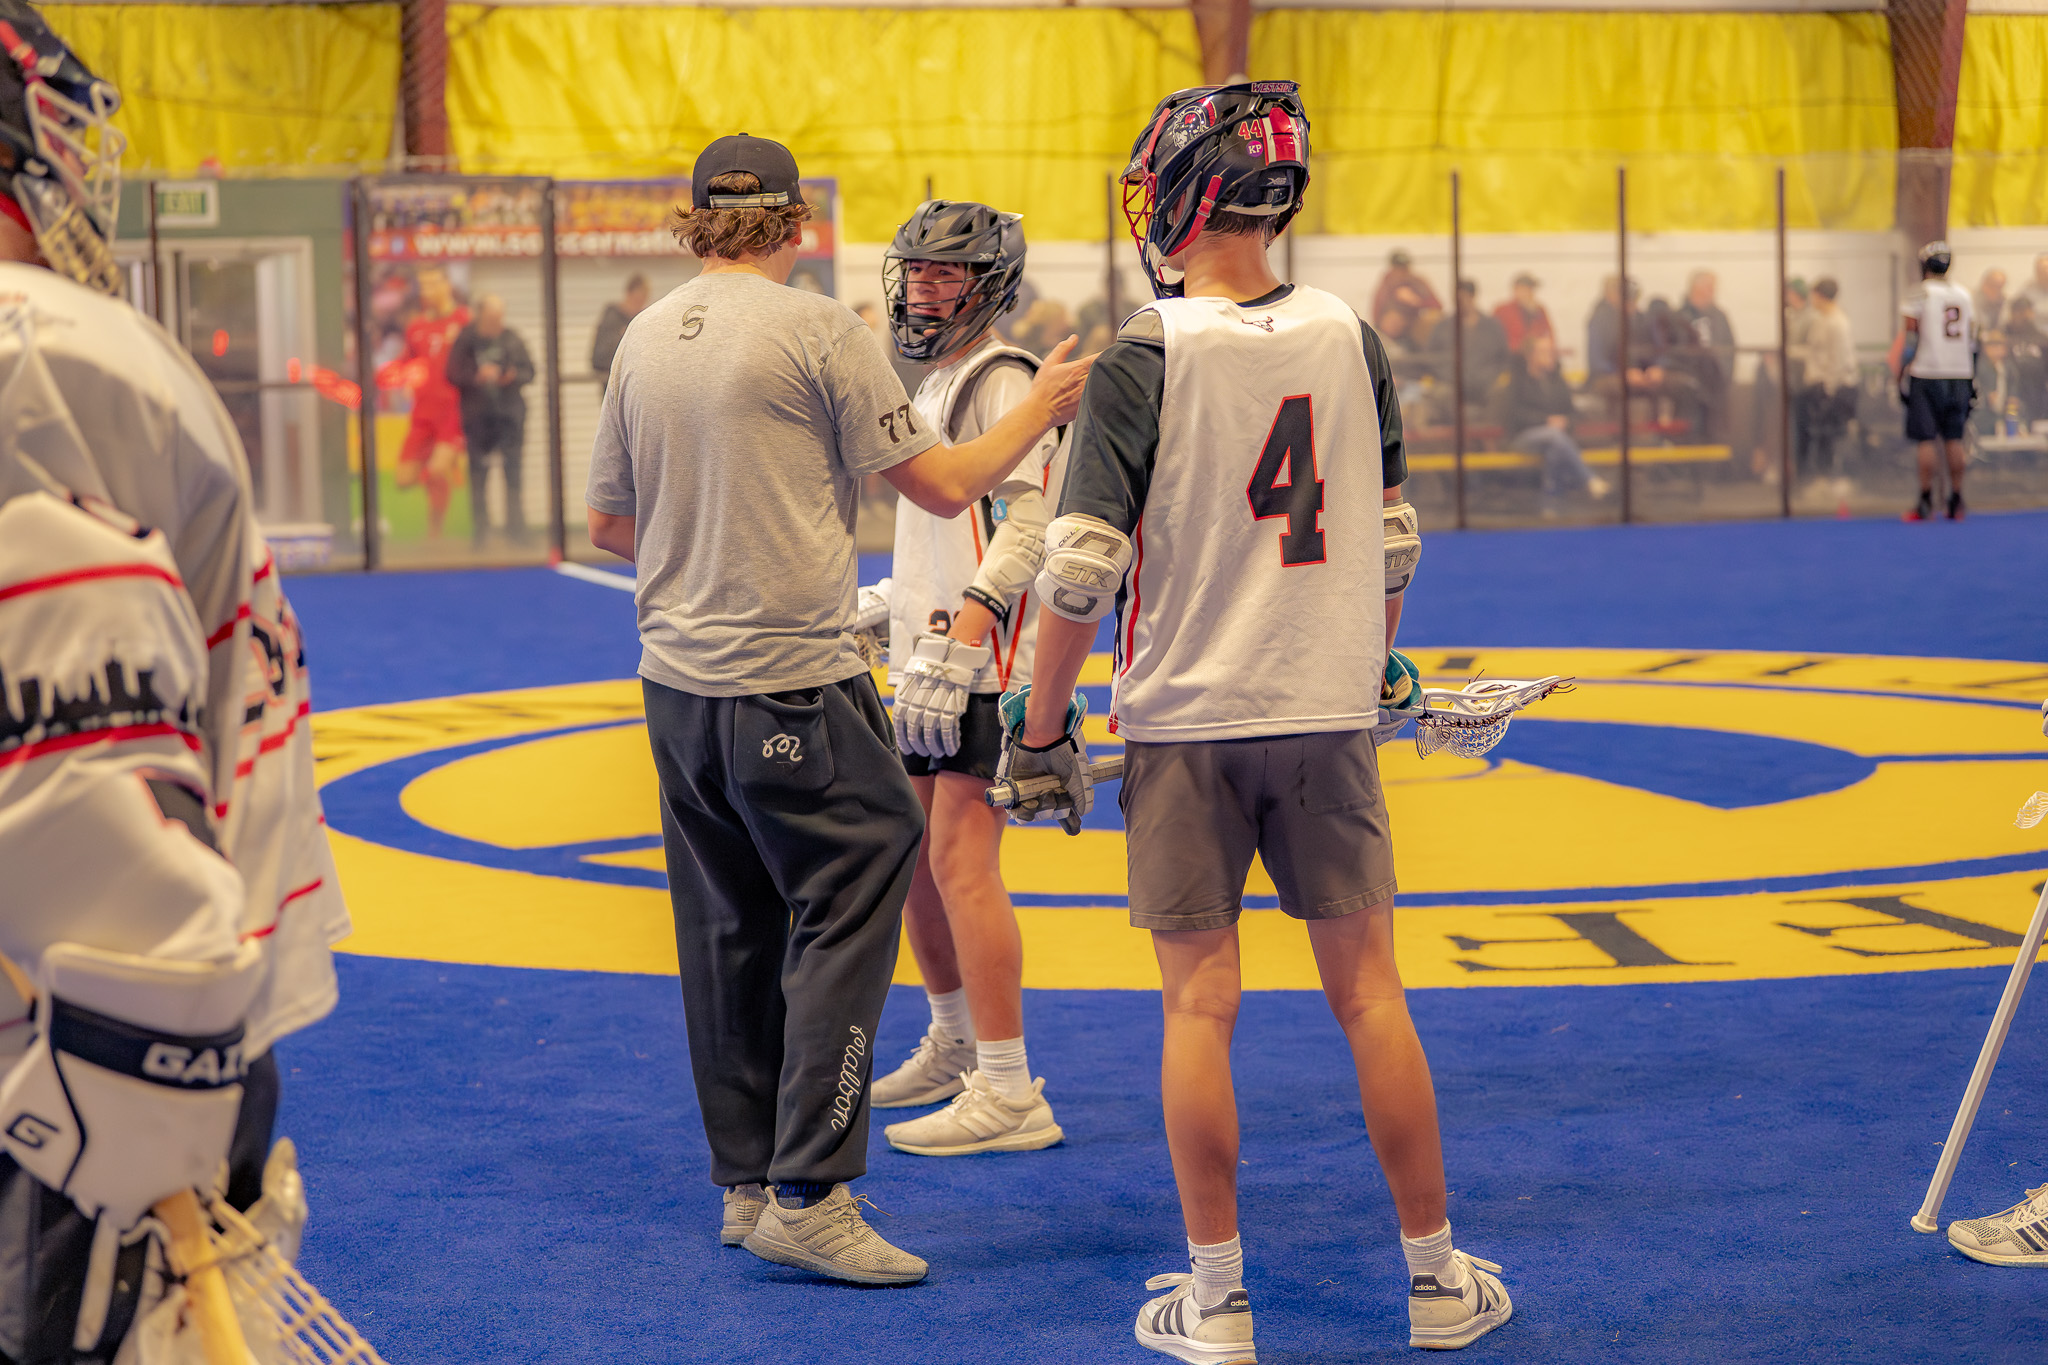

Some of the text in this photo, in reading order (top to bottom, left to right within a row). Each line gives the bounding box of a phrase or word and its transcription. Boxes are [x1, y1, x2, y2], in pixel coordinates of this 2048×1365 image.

[1251, 82, 1295, 93] WESTSIDE
[1238, 119, 1263, 140] 44
[1248, 144, 1262, 155] KP
[1944, 306, 1961, 339] 2
[878, 403, 917, 445] 77
[1246, 393, 1327, 568] 4
[1058, 561, 1114, 588] STX
[928, 609, 961, 637] 2
[1230, 1299, 1249, 1307] adida
